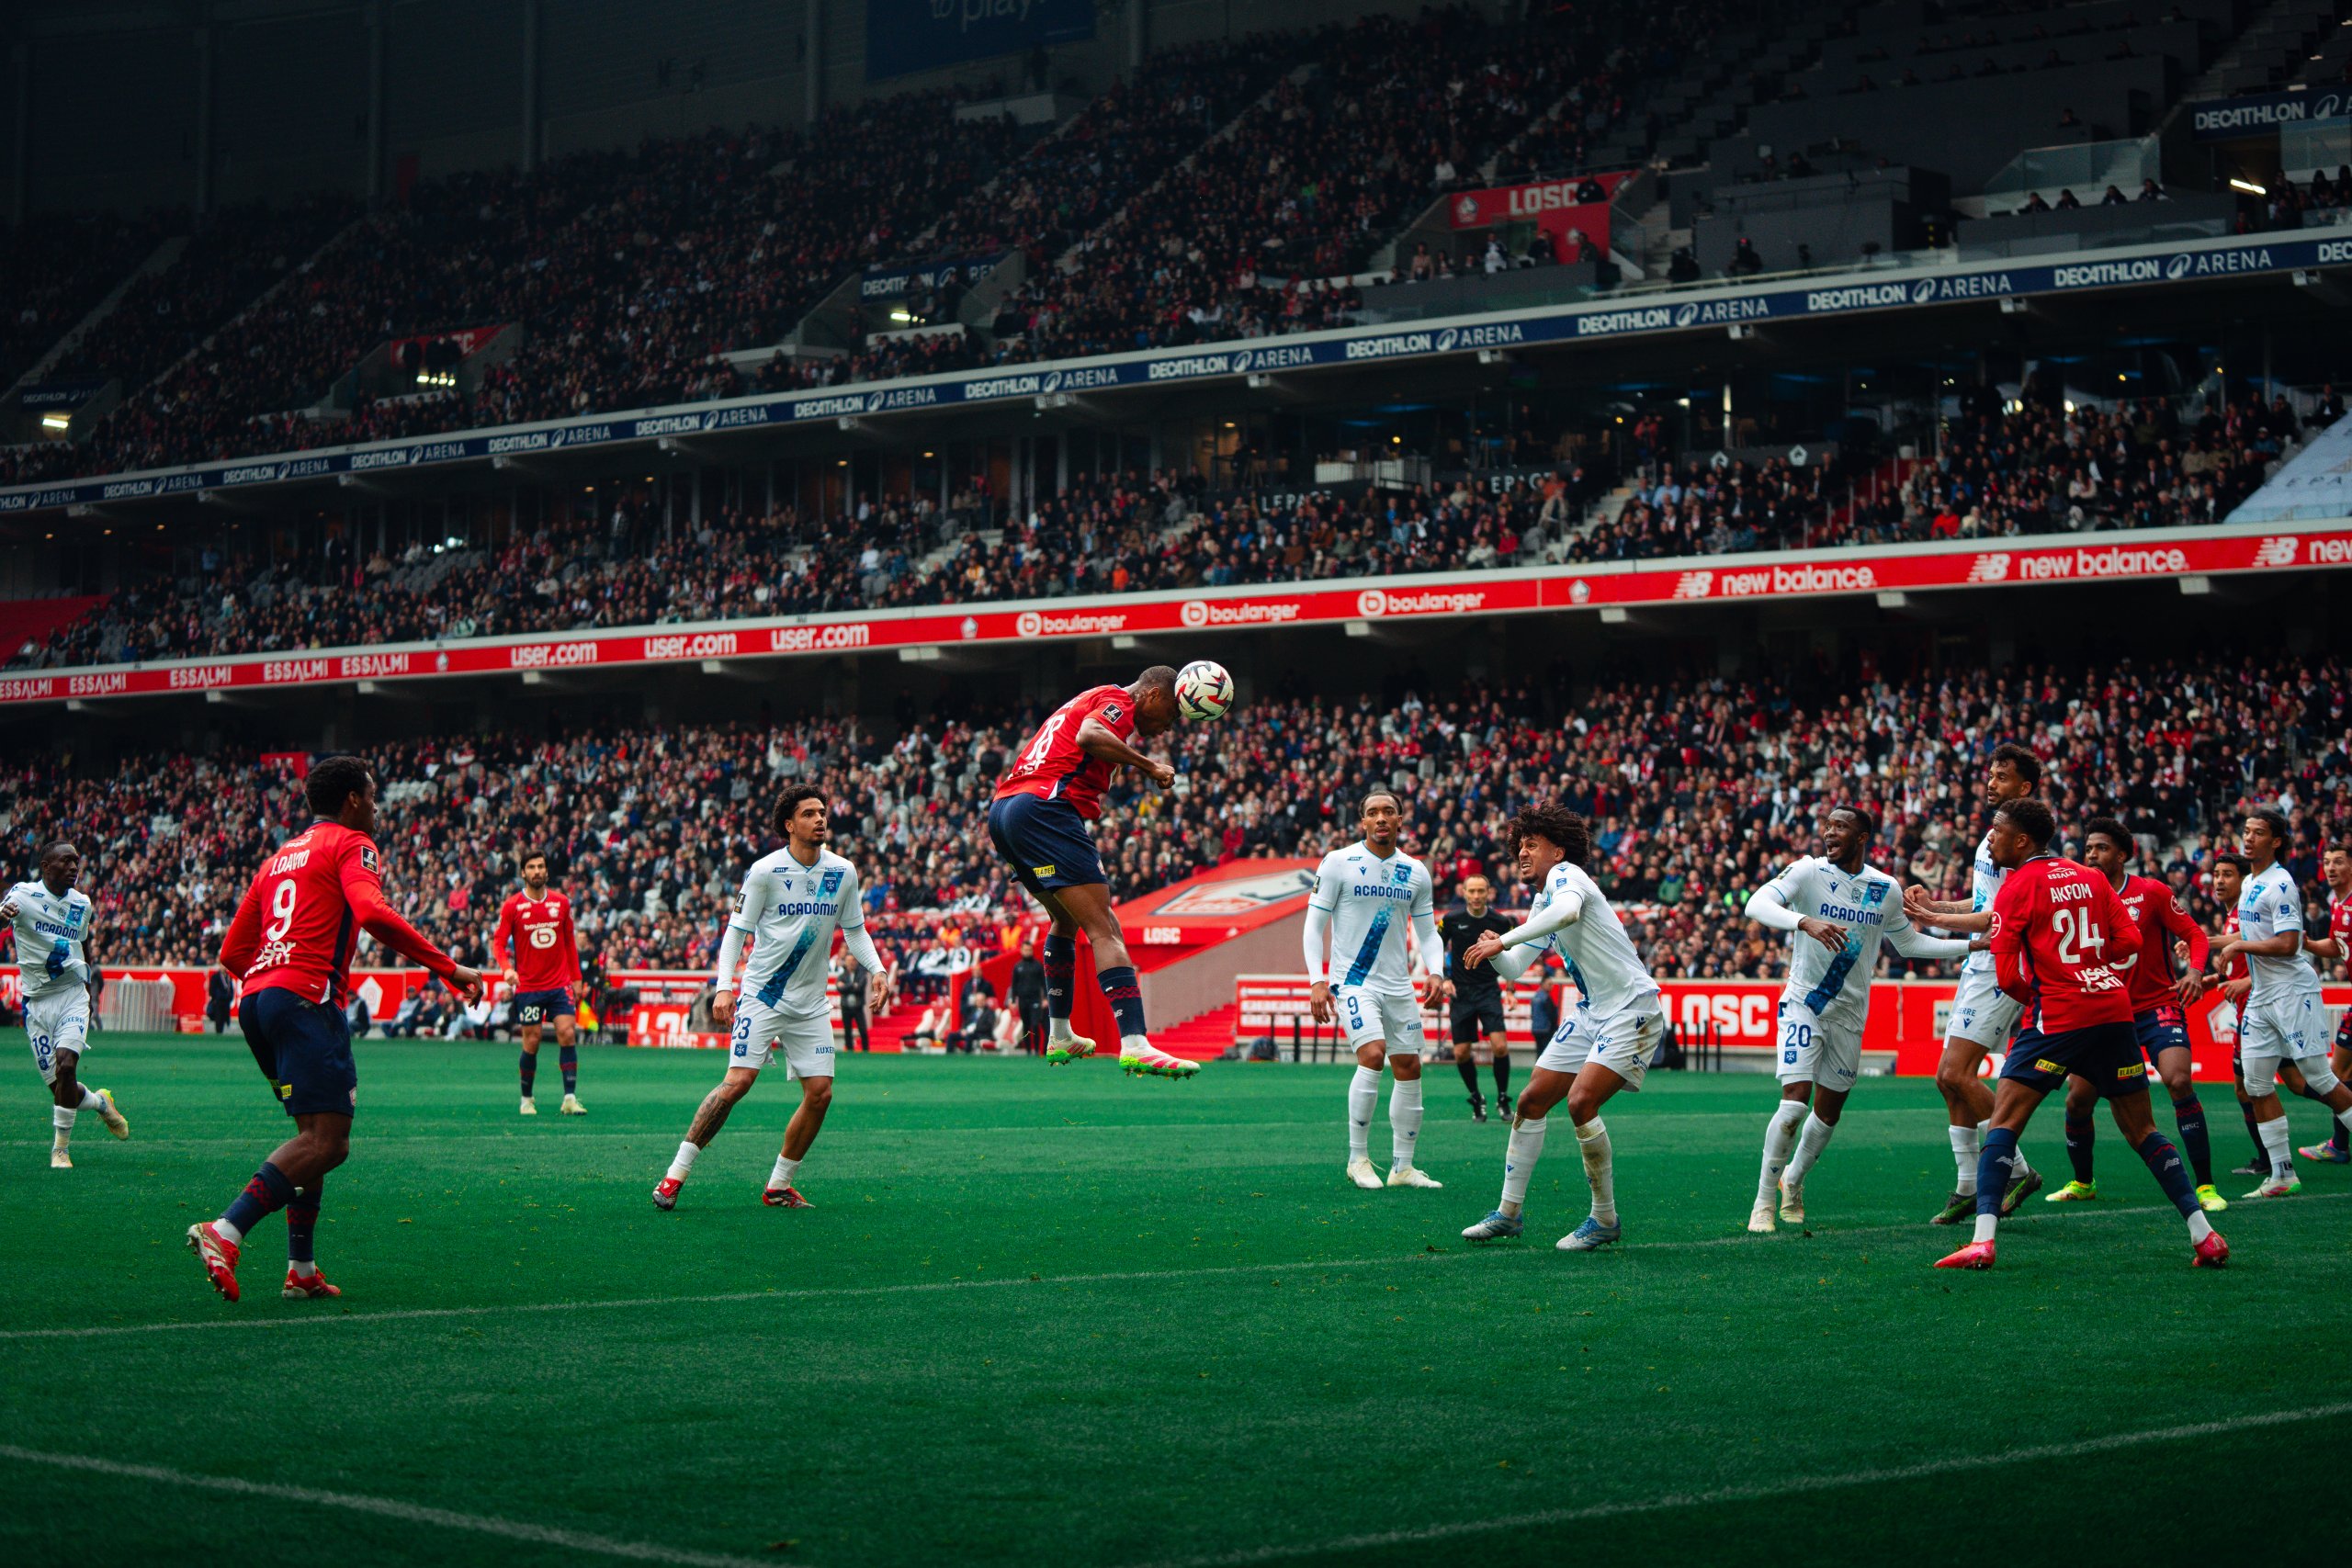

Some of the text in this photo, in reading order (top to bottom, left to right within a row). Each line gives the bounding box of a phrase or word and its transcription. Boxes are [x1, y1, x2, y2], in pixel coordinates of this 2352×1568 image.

[2195, 101, 2306, 130] DECATHLON
[2054, 249, 2273, 287] DECATHLON ARENA
[1808, 274, 2012, 310] DECATHLON ARENA
[1578, 298, 1770, 334] DECATHLON ARENA
[1346, 324, 1523, 358] DECATHLON ARENA
[1148, 346, 1313, 378] DECATHLON ARENA
[965, 367, 1118, 399] DECATHLON ARENA
[794, 388, 936, 418] DECATHLON ARENA
[635, 406, 768, 436] DECATHLON ARENA
[488, 425, 612, 453] DECATHLON ARENA
[351, 443, 466, 469] DECATHLON ARENA
[223, 459, 330, 484] DECATHLON ARENA
[41, 490, 76, 505] ARENA
[103, 474, 204, 499] DECATHLON ARENA
[2019, 554, 2075, 580] new
[2075, 547, 2187, 576] balance
[1720, 570, 1770, 596] new
[1772, 564, 1873, 590] balance
[1209, 603, 1301, 625] boulanger
[1388, 591, 1486, 614] boulanger
[771, 624, 869, 650] user.com
[1041, 614, 1127, 633] boulanger
[511, 642, 597, 668] user.com
[644, 632, 737, 660] user.com
[1354, 885, 1412, 901] ACADOMIA
[2050, 883, 2093, 903] AKPOM
[266, 878, 297, 942] 9
[1819, 903, 1883, 926] ACADOMIA
[1143, 927, 1182, 945] LOSC
[2052, 906, 2106, 965] 24
[1347, 995, 1359, 1015] 9
[1658, 994, 1770, 1037] LOSC
[33, 1034, 51, 1056] 18
[1785, 1024, 1811, 1048] 20
